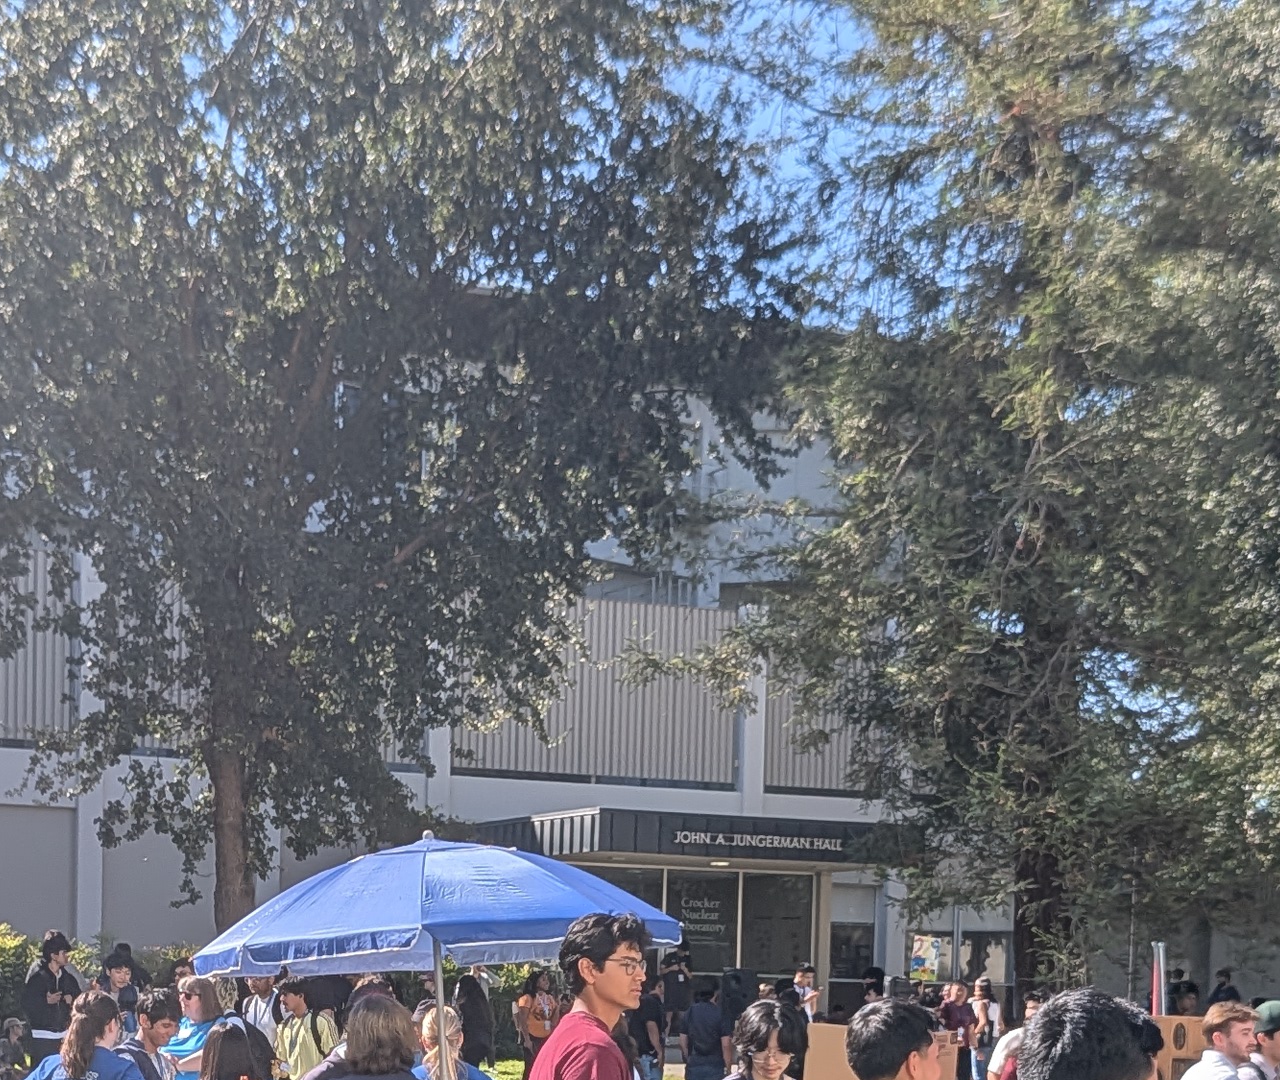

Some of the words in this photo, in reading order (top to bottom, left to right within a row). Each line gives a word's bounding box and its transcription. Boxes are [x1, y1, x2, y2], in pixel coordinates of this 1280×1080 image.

[674, 831, 710, 844] JOHN
[732, 834, 810, 849] JUNGERMAN
[813, 838, 842, 851] HALL
[681, 897, 720, 908] Crocker
[681, 908, 720, 920] Nuclear
